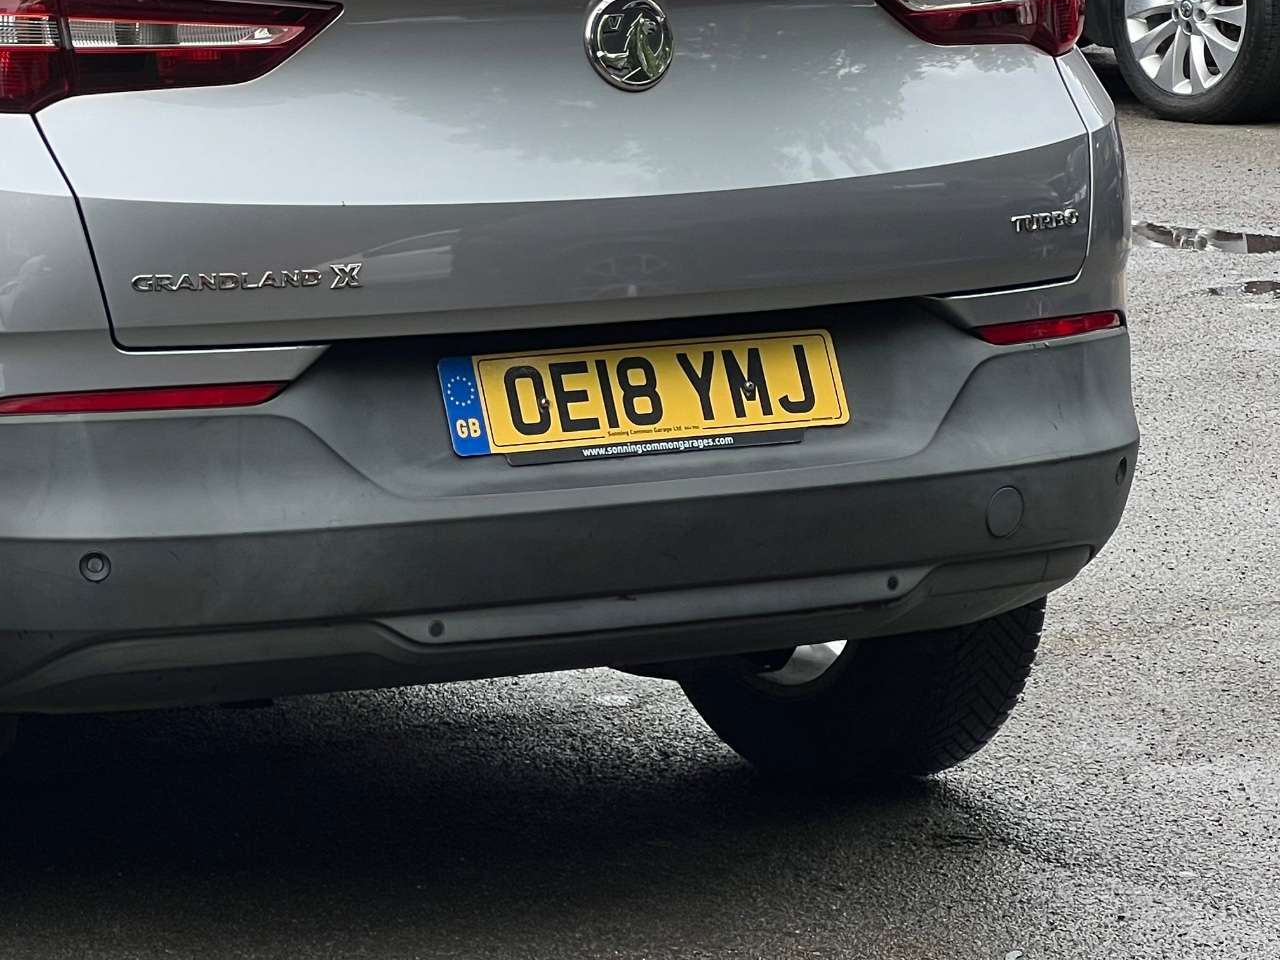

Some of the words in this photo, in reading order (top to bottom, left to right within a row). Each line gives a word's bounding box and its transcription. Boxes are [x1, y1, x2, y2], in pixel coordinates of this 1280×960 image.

[1010, 208, 1080, 233] TURBO
[131, 269, 322, 292] GRANDLAND
[328, 263, 363, 290] X
[503, 356, 664, 436] OE18
[676, 344, 816, 421] YMJ
[456, 417, 481, 438] GB
[582, 436, 734, 458] www.sonningcommongarages.com
